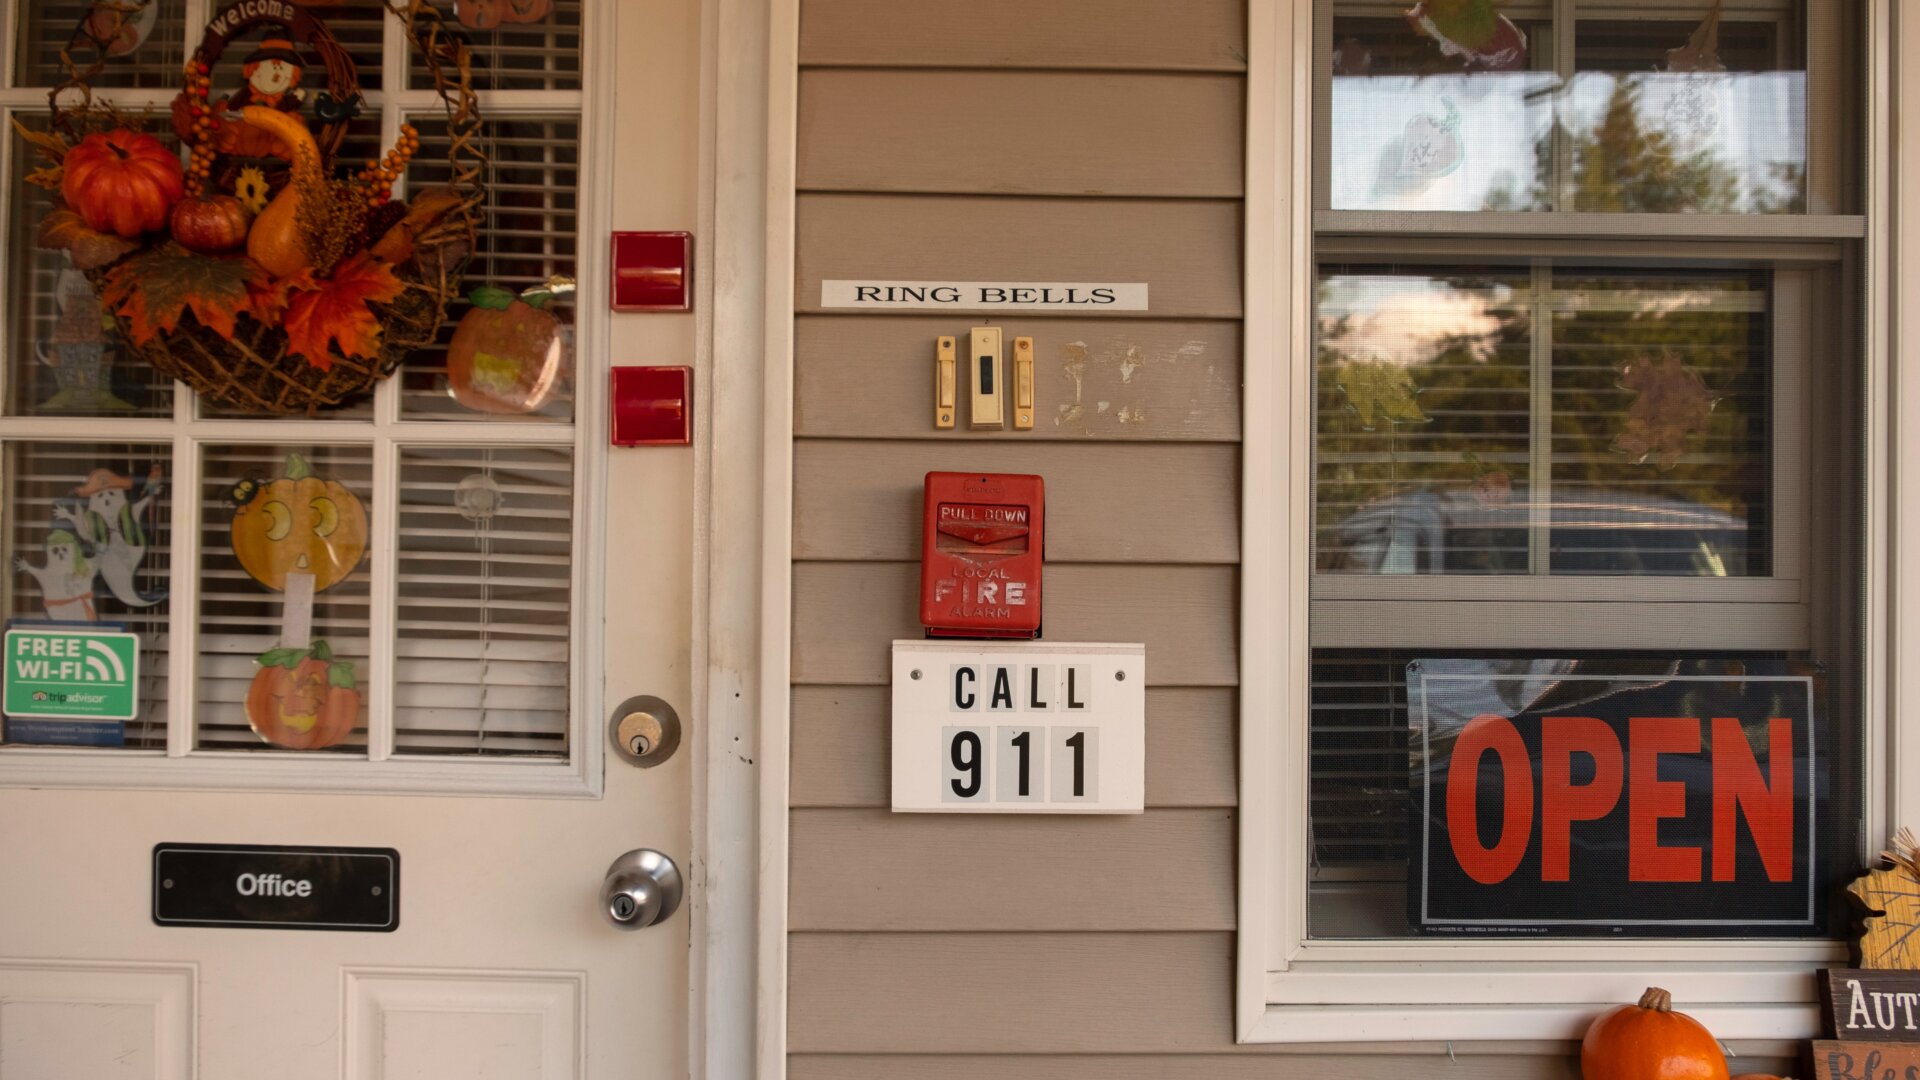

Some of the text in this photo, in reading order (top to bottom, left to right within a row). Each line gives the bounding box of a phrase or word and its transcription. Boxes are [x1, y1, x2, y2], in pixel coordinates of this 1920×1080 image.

[854, 286, 1116, 304] RING BELLS
[941, 507, 1026, 523] PULL DOWN
[953, 567, 1010, 580] LOCAL
[935, 579, 1026, 605] FIRE
[950, 606, 1011, 618] ALARM
[17, 637, 81, 657] FREE
[16, 660, 82, 680] WI-FI
[48, 692, 104, 704] tripadvisor
[955, 667, 1084, 709] CALL
[951, 731, 1084, 798] 911
[1446, 713, 1793, 885] OPEN
[236, 872, 312, 897] Office
[1846, 979, 1920, 1030] AUT
